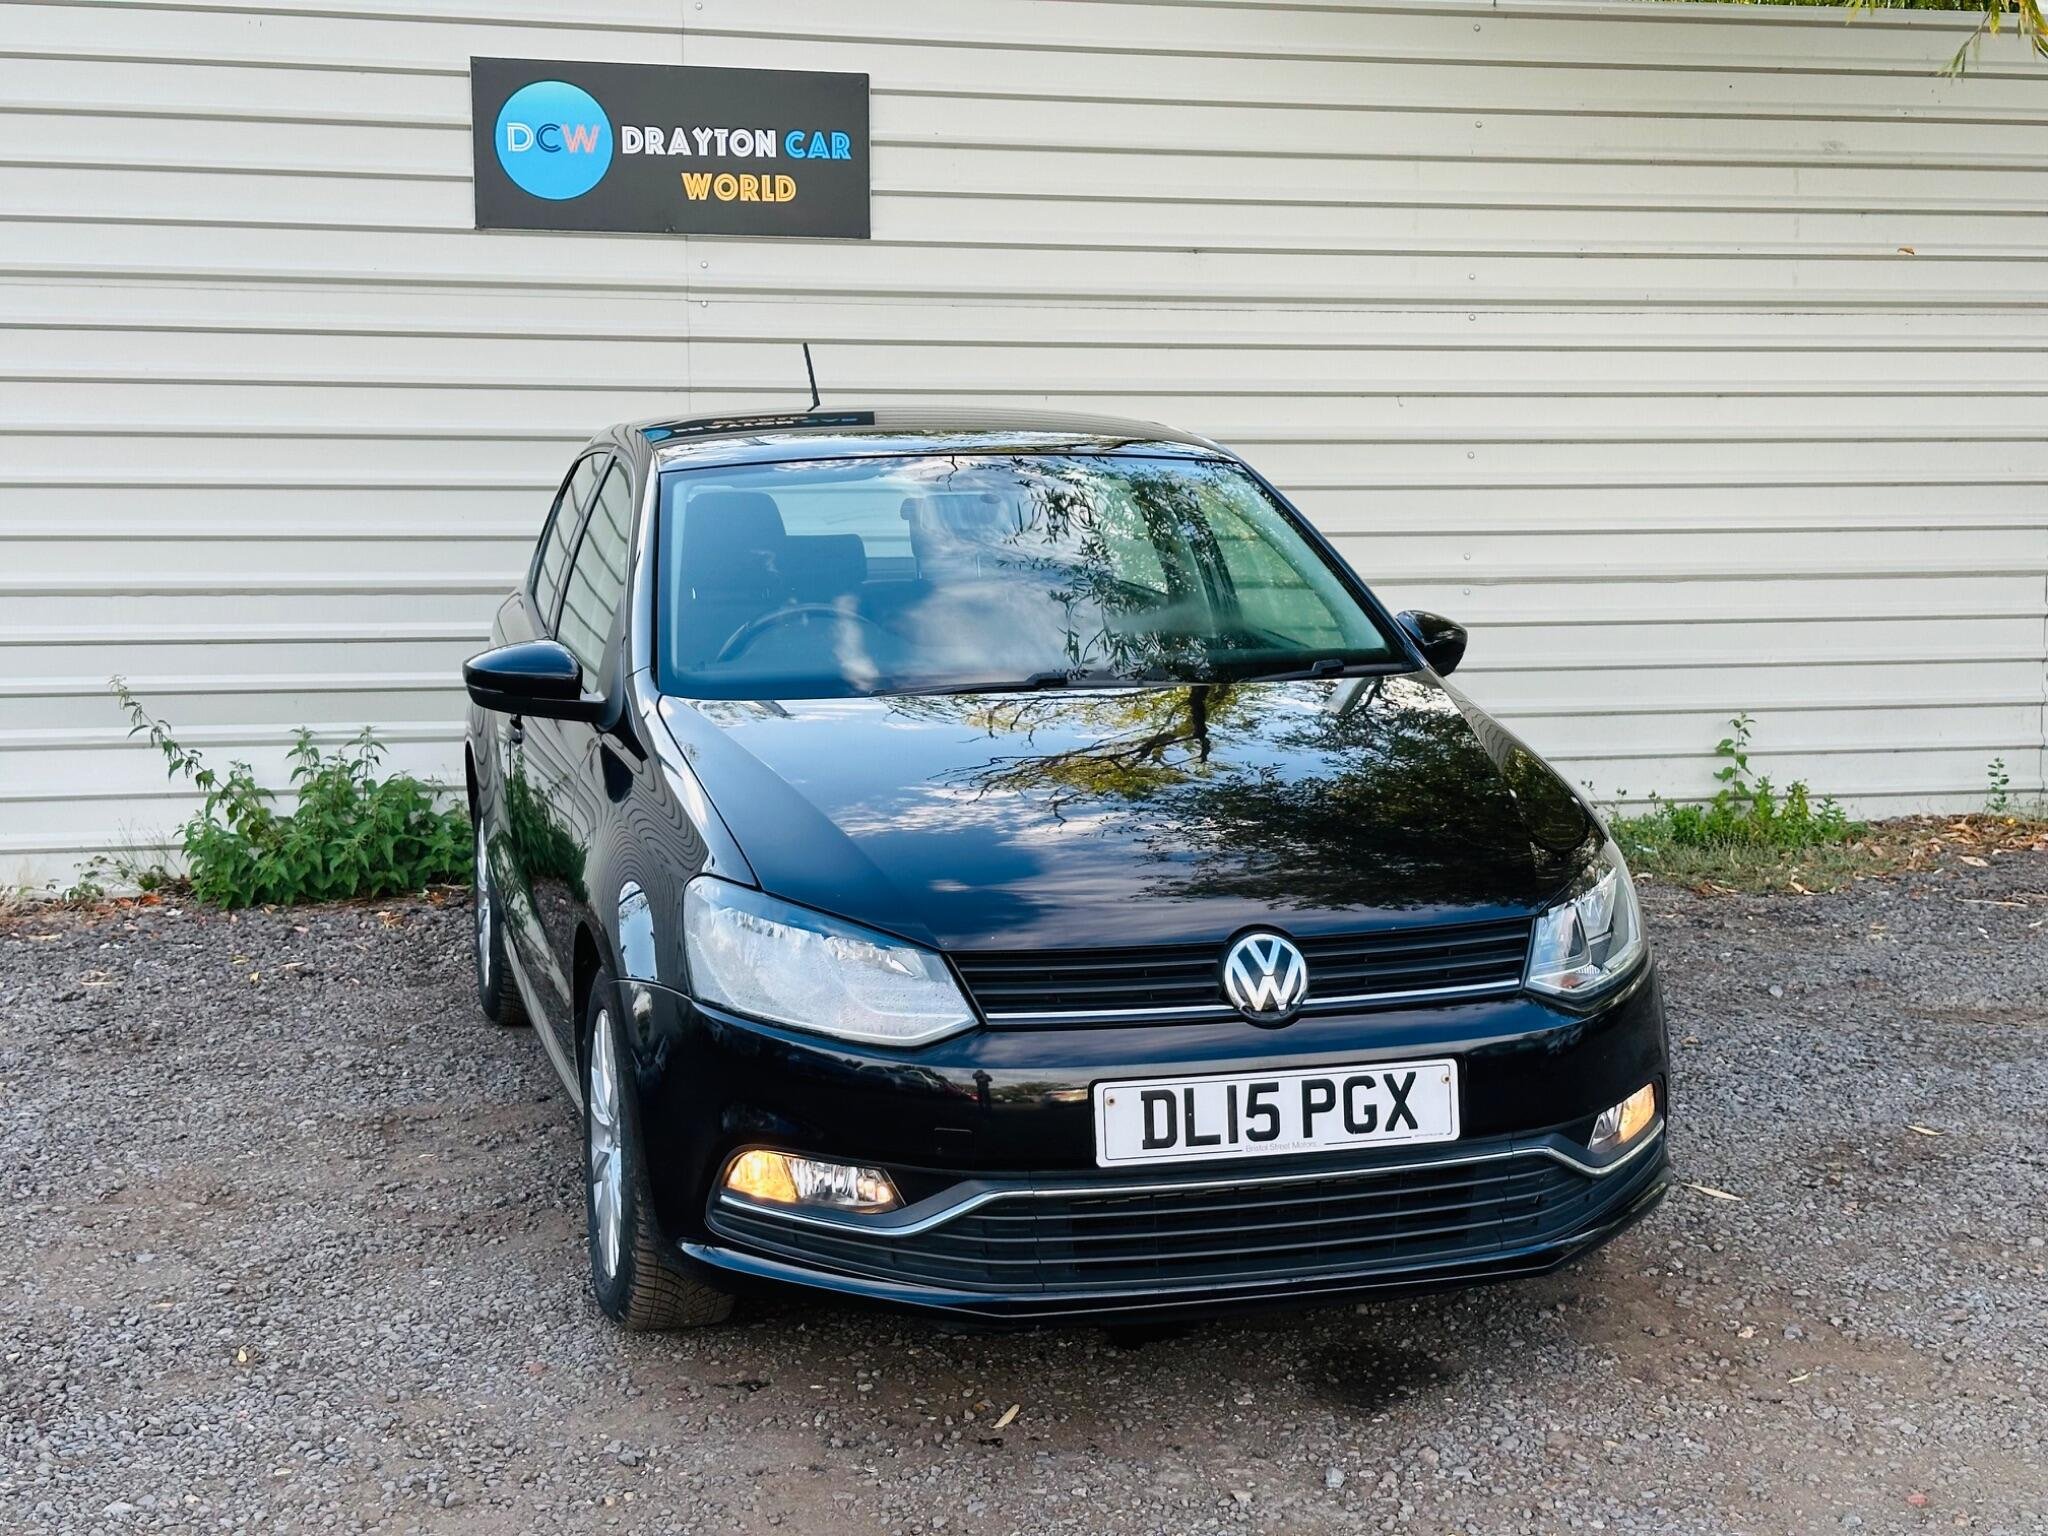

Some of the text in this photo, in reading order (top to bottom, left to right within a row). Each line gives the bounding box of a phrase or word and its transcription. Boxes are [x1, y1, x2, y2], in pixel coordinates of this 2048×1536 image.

[507, 122, 599, 154] DCW
[621, 125, 852, 160] DRAYTON CAR
[681, 172, 797, 202] WORLD
[1231, 939, 1301, 1012] VW
[1140, 1071, 1418, 1150] DL15 PGX
